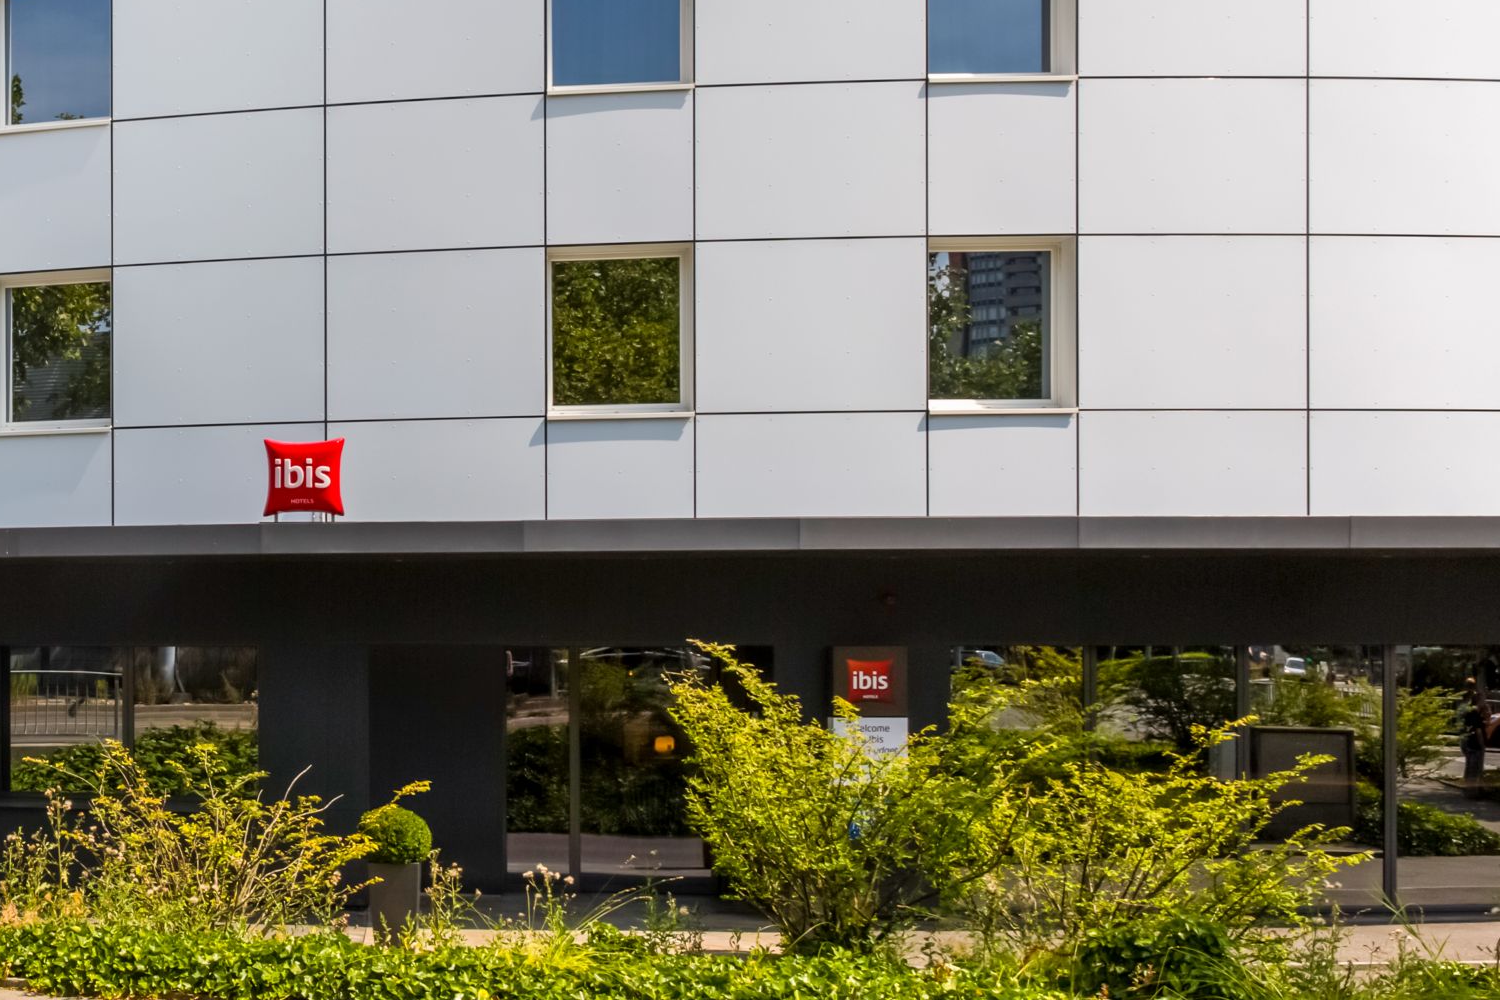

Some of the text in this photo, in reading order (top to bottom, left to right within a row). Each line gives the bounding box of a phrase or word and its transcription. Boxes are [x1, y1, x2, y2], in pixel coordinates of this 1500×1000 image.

[274, 458, 331, 488] ibis
[852, 671, 888, 689] ibis
[856, 724, 890, 732] elcome
